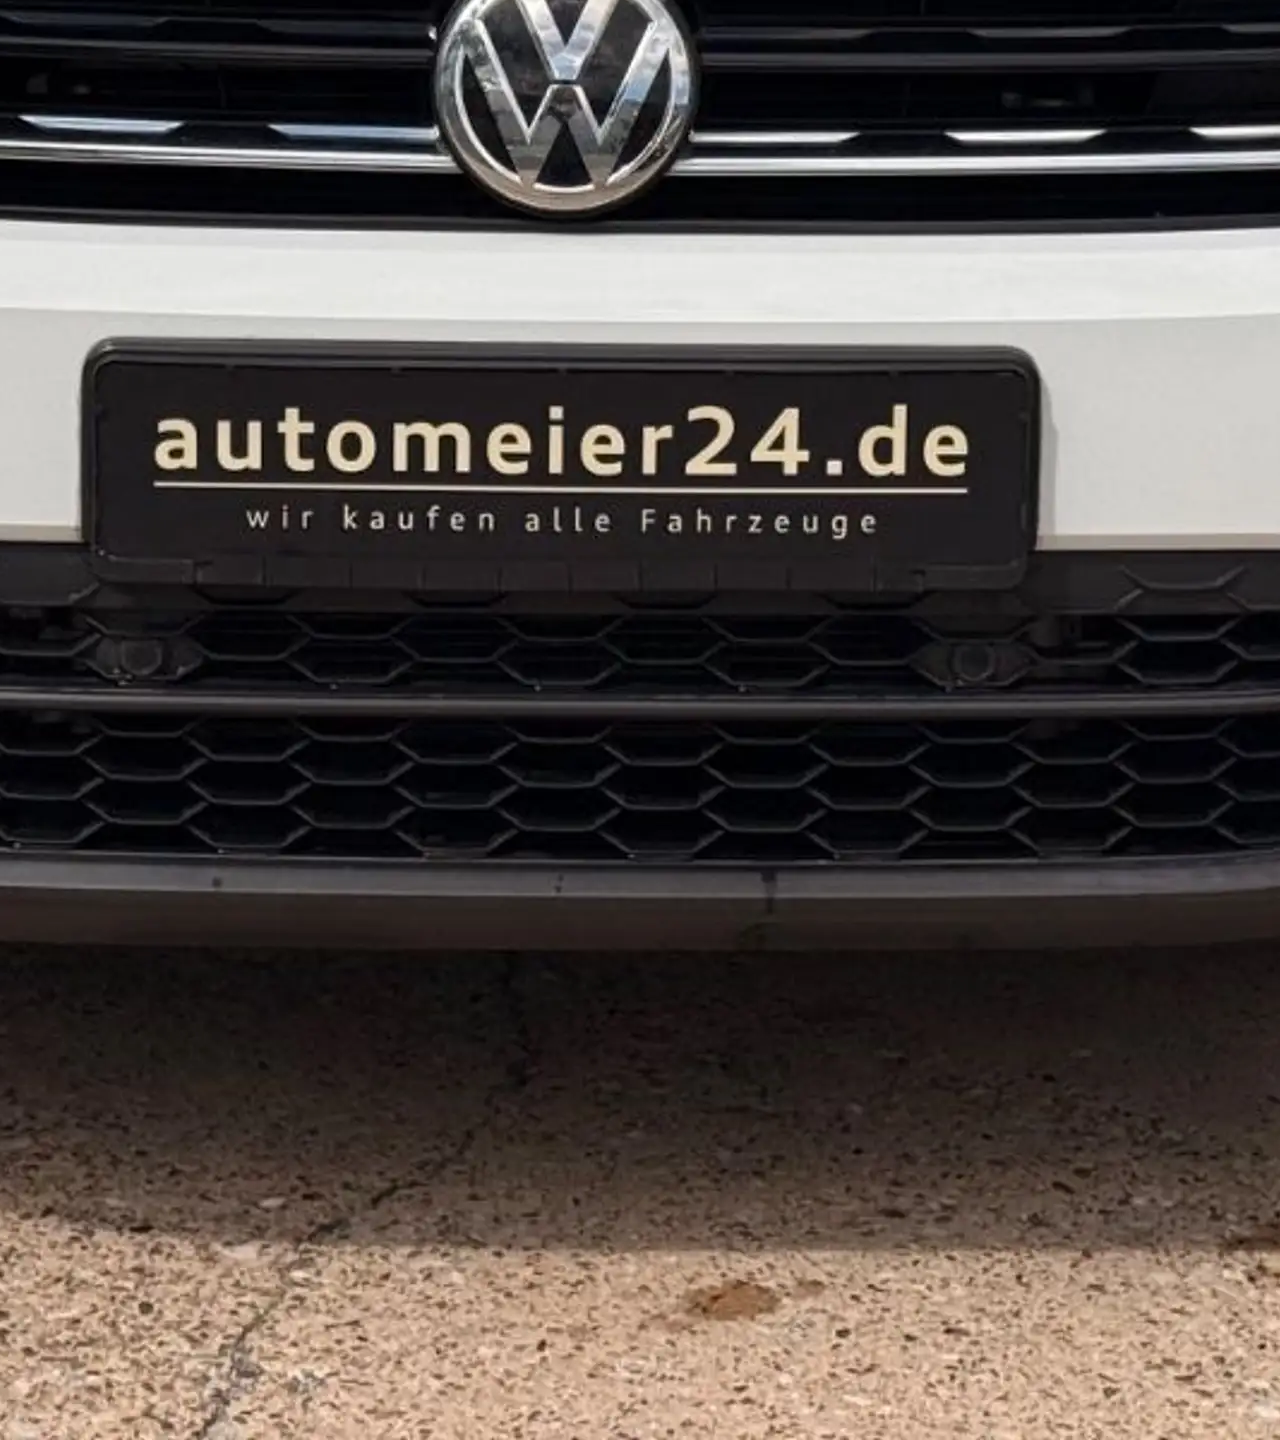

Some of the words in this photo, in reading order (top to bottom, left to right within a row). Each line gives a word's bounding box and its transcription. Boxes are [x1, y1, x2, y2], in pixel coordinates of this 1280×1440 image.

[153, 403, 969, 478] automeier24.de
[245, 505, 314, 530] wir
[342, 504, 496, 532] kaufen
[524, 506, 611, 534] alle
[641, 508, 877, 541] Fahrzeuge
